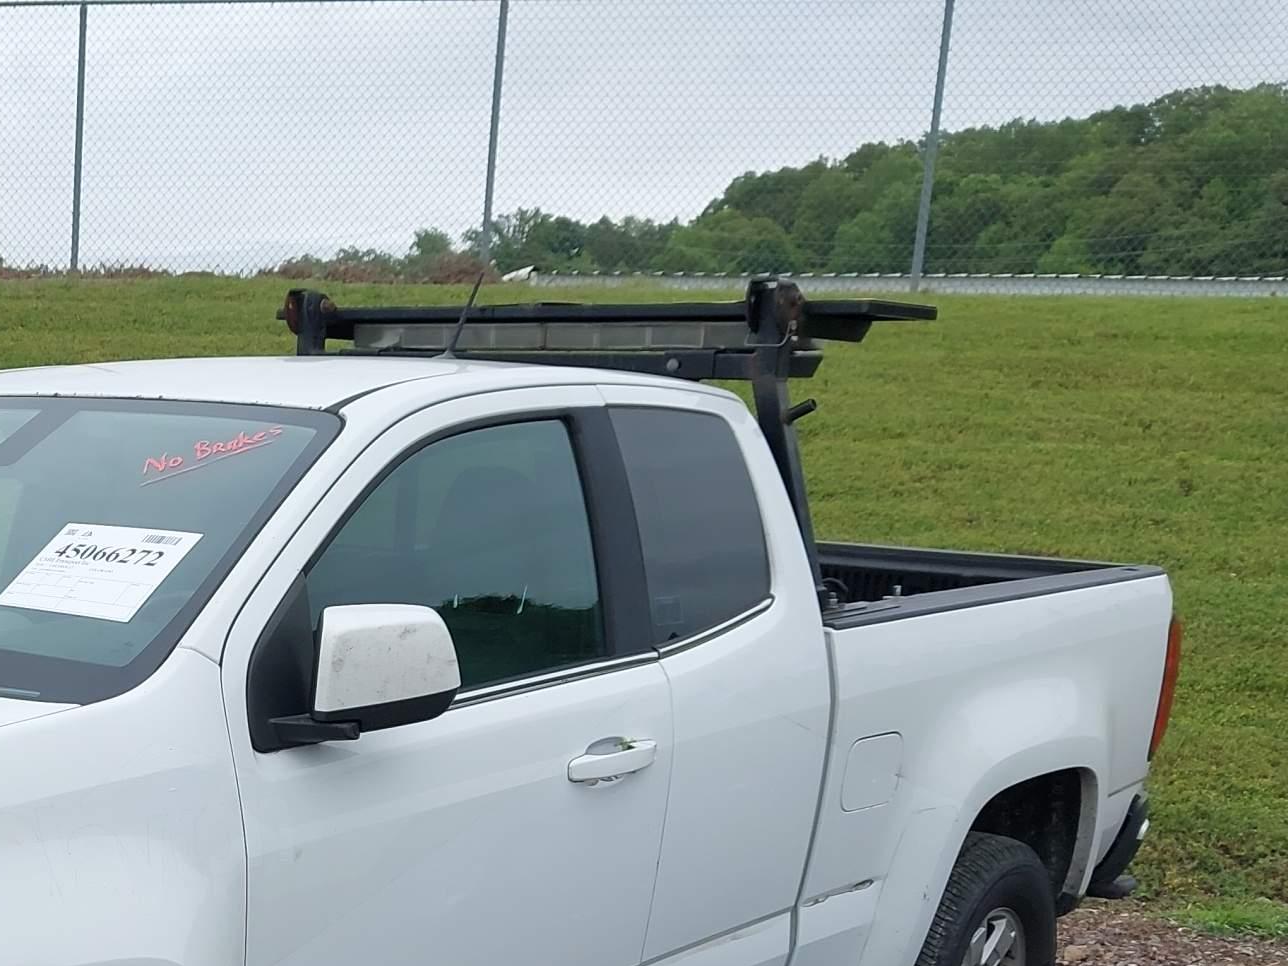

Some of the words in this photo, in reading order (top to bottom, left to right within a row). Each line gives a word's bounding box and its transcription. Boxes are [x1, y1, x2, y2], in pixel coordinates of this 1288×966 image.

[143, 451, 184, 474] No
[193, 424, 283, 461] Brakes
[54, 542, 165, 567] 45066272
